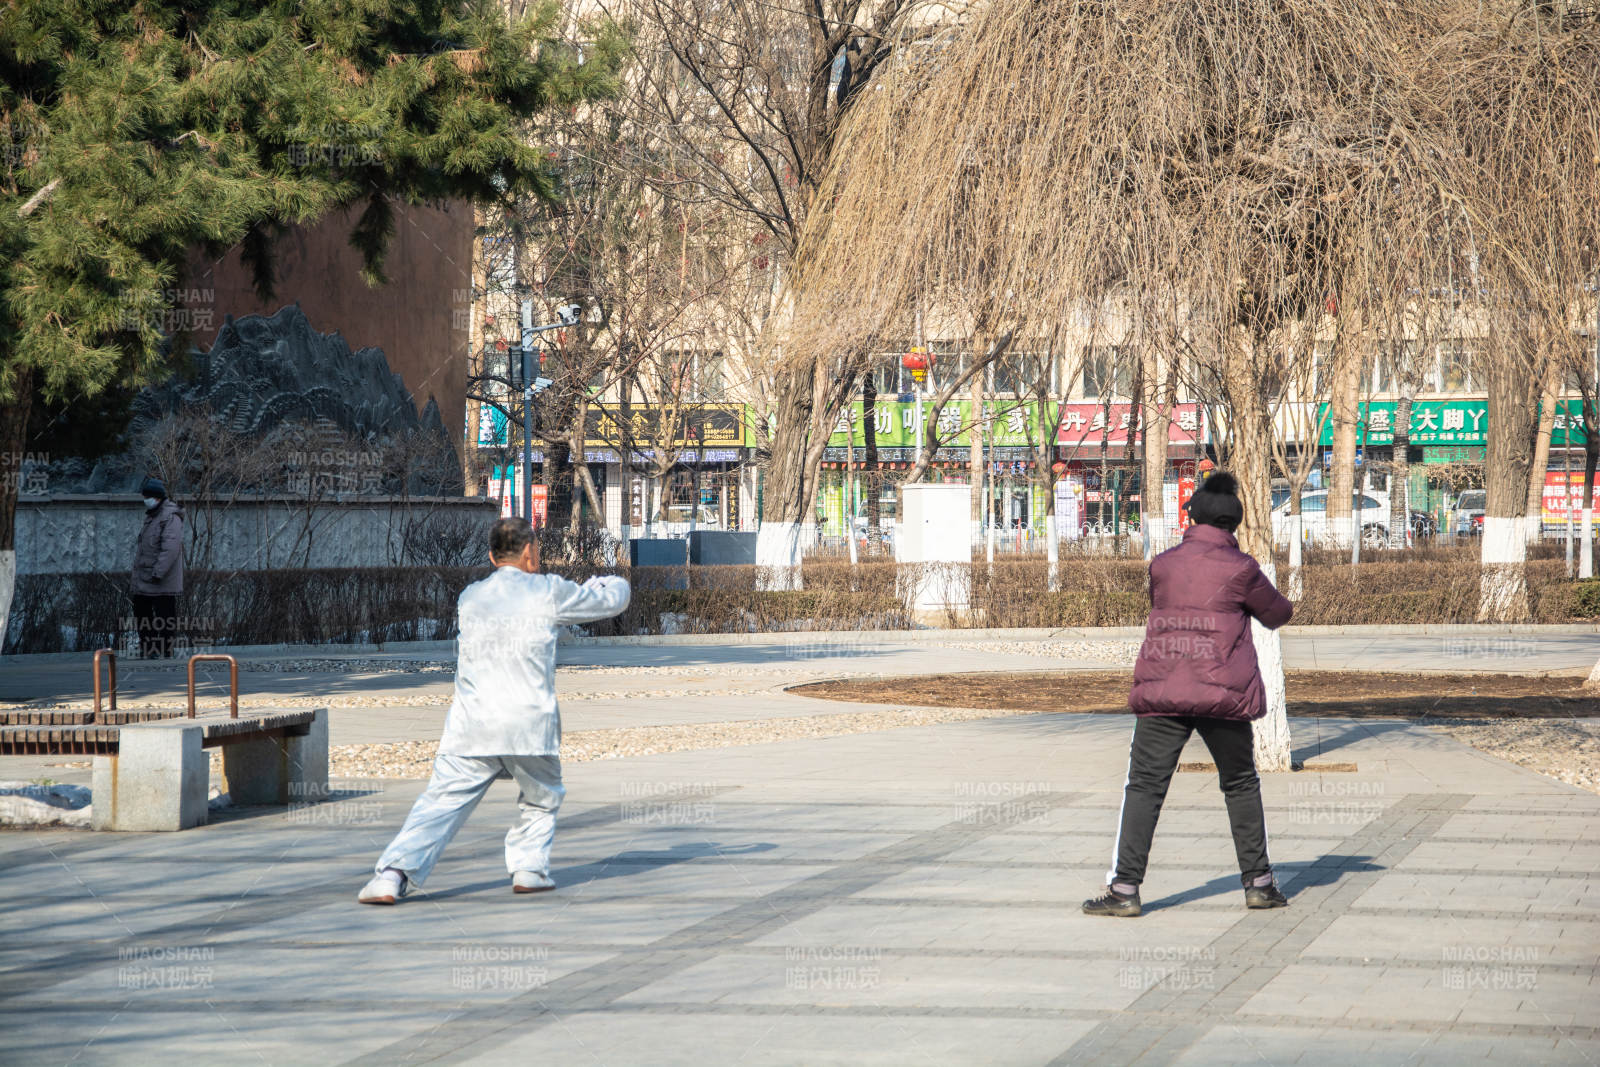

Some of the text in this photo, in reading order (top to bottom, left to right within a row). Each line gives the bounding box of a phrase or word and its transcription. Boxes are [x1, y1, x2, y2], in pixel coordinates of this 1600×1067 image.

[833, 406, 1031, 434] 助听器家
[1061, 411, 1203, 432] 丹麦助器
[1368, 409, 1486, 431] 盛大脚丫
